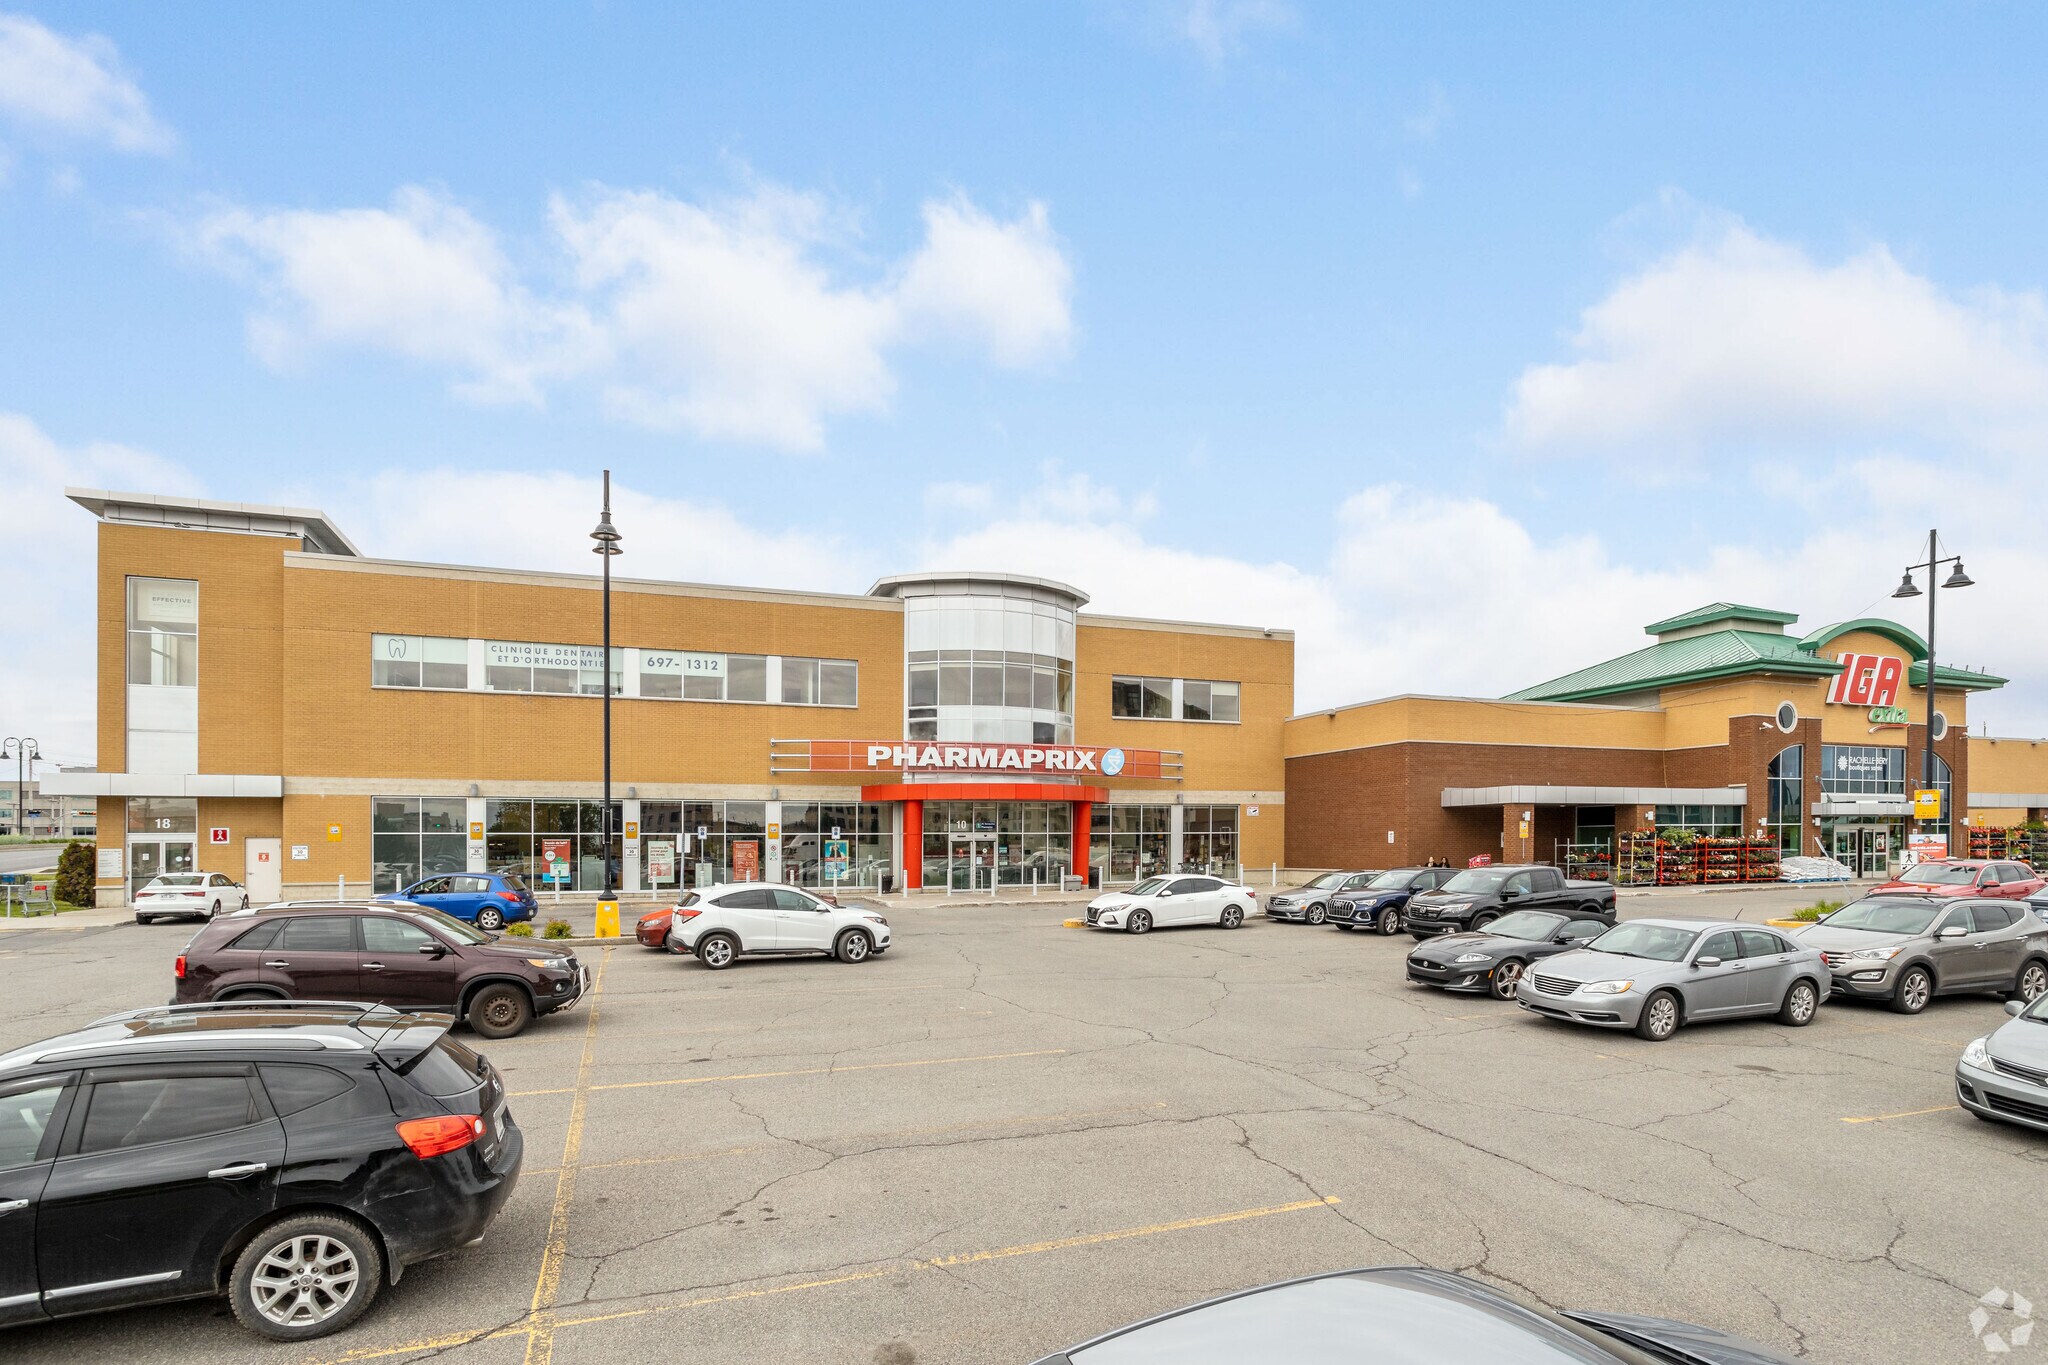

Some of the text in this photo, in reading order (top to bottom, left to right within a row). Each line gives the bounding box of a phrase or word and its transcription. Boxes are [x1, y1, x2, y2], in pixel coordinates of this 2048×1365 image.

[491, 645, 605, 658] CLINIQUE DENTAIR
[497, 655, 604, 668] ET D'ORTHODONTIE
[1826, 652, 1903, 707] IGA
[1869, 706, 1908, 723] extra
[867, 745, 1096, 771] PHARMAPRIX
[1895, 805, 1902, 813] 12
[155, 818, 171, 829] 18
[957, 820, 967, 829] 10
